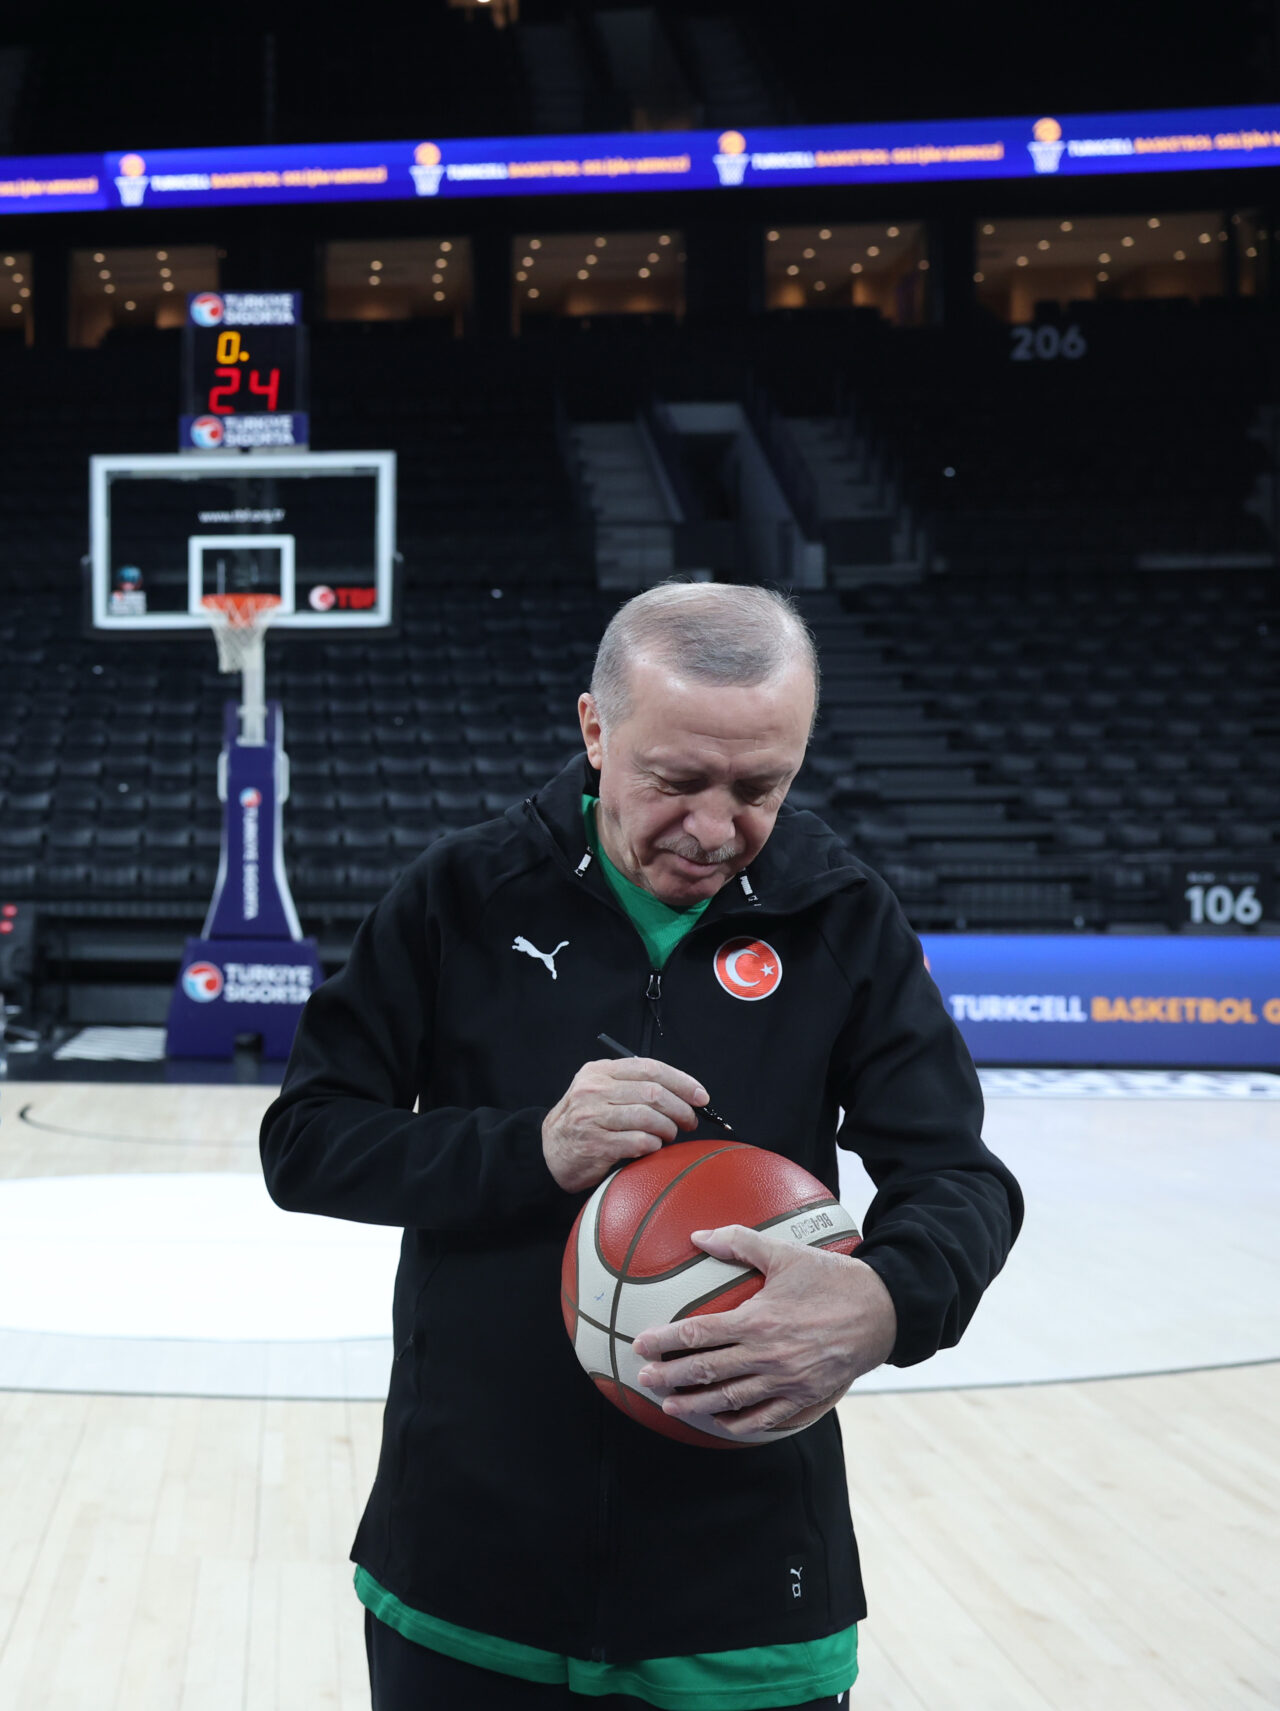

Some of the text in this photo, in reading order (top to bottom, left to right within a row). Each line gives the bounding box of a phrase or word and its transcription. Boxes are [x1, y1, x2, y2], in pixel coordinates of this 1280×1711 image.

[1009, 325, 1086, 360] 206
[208, 367, 280, 414] 24
[1184, 884, 1263, 926] 106
[949, 994, 1087, 1023] TURKCELL
[1090, 996, 1257, 1024] BASKETBOL
